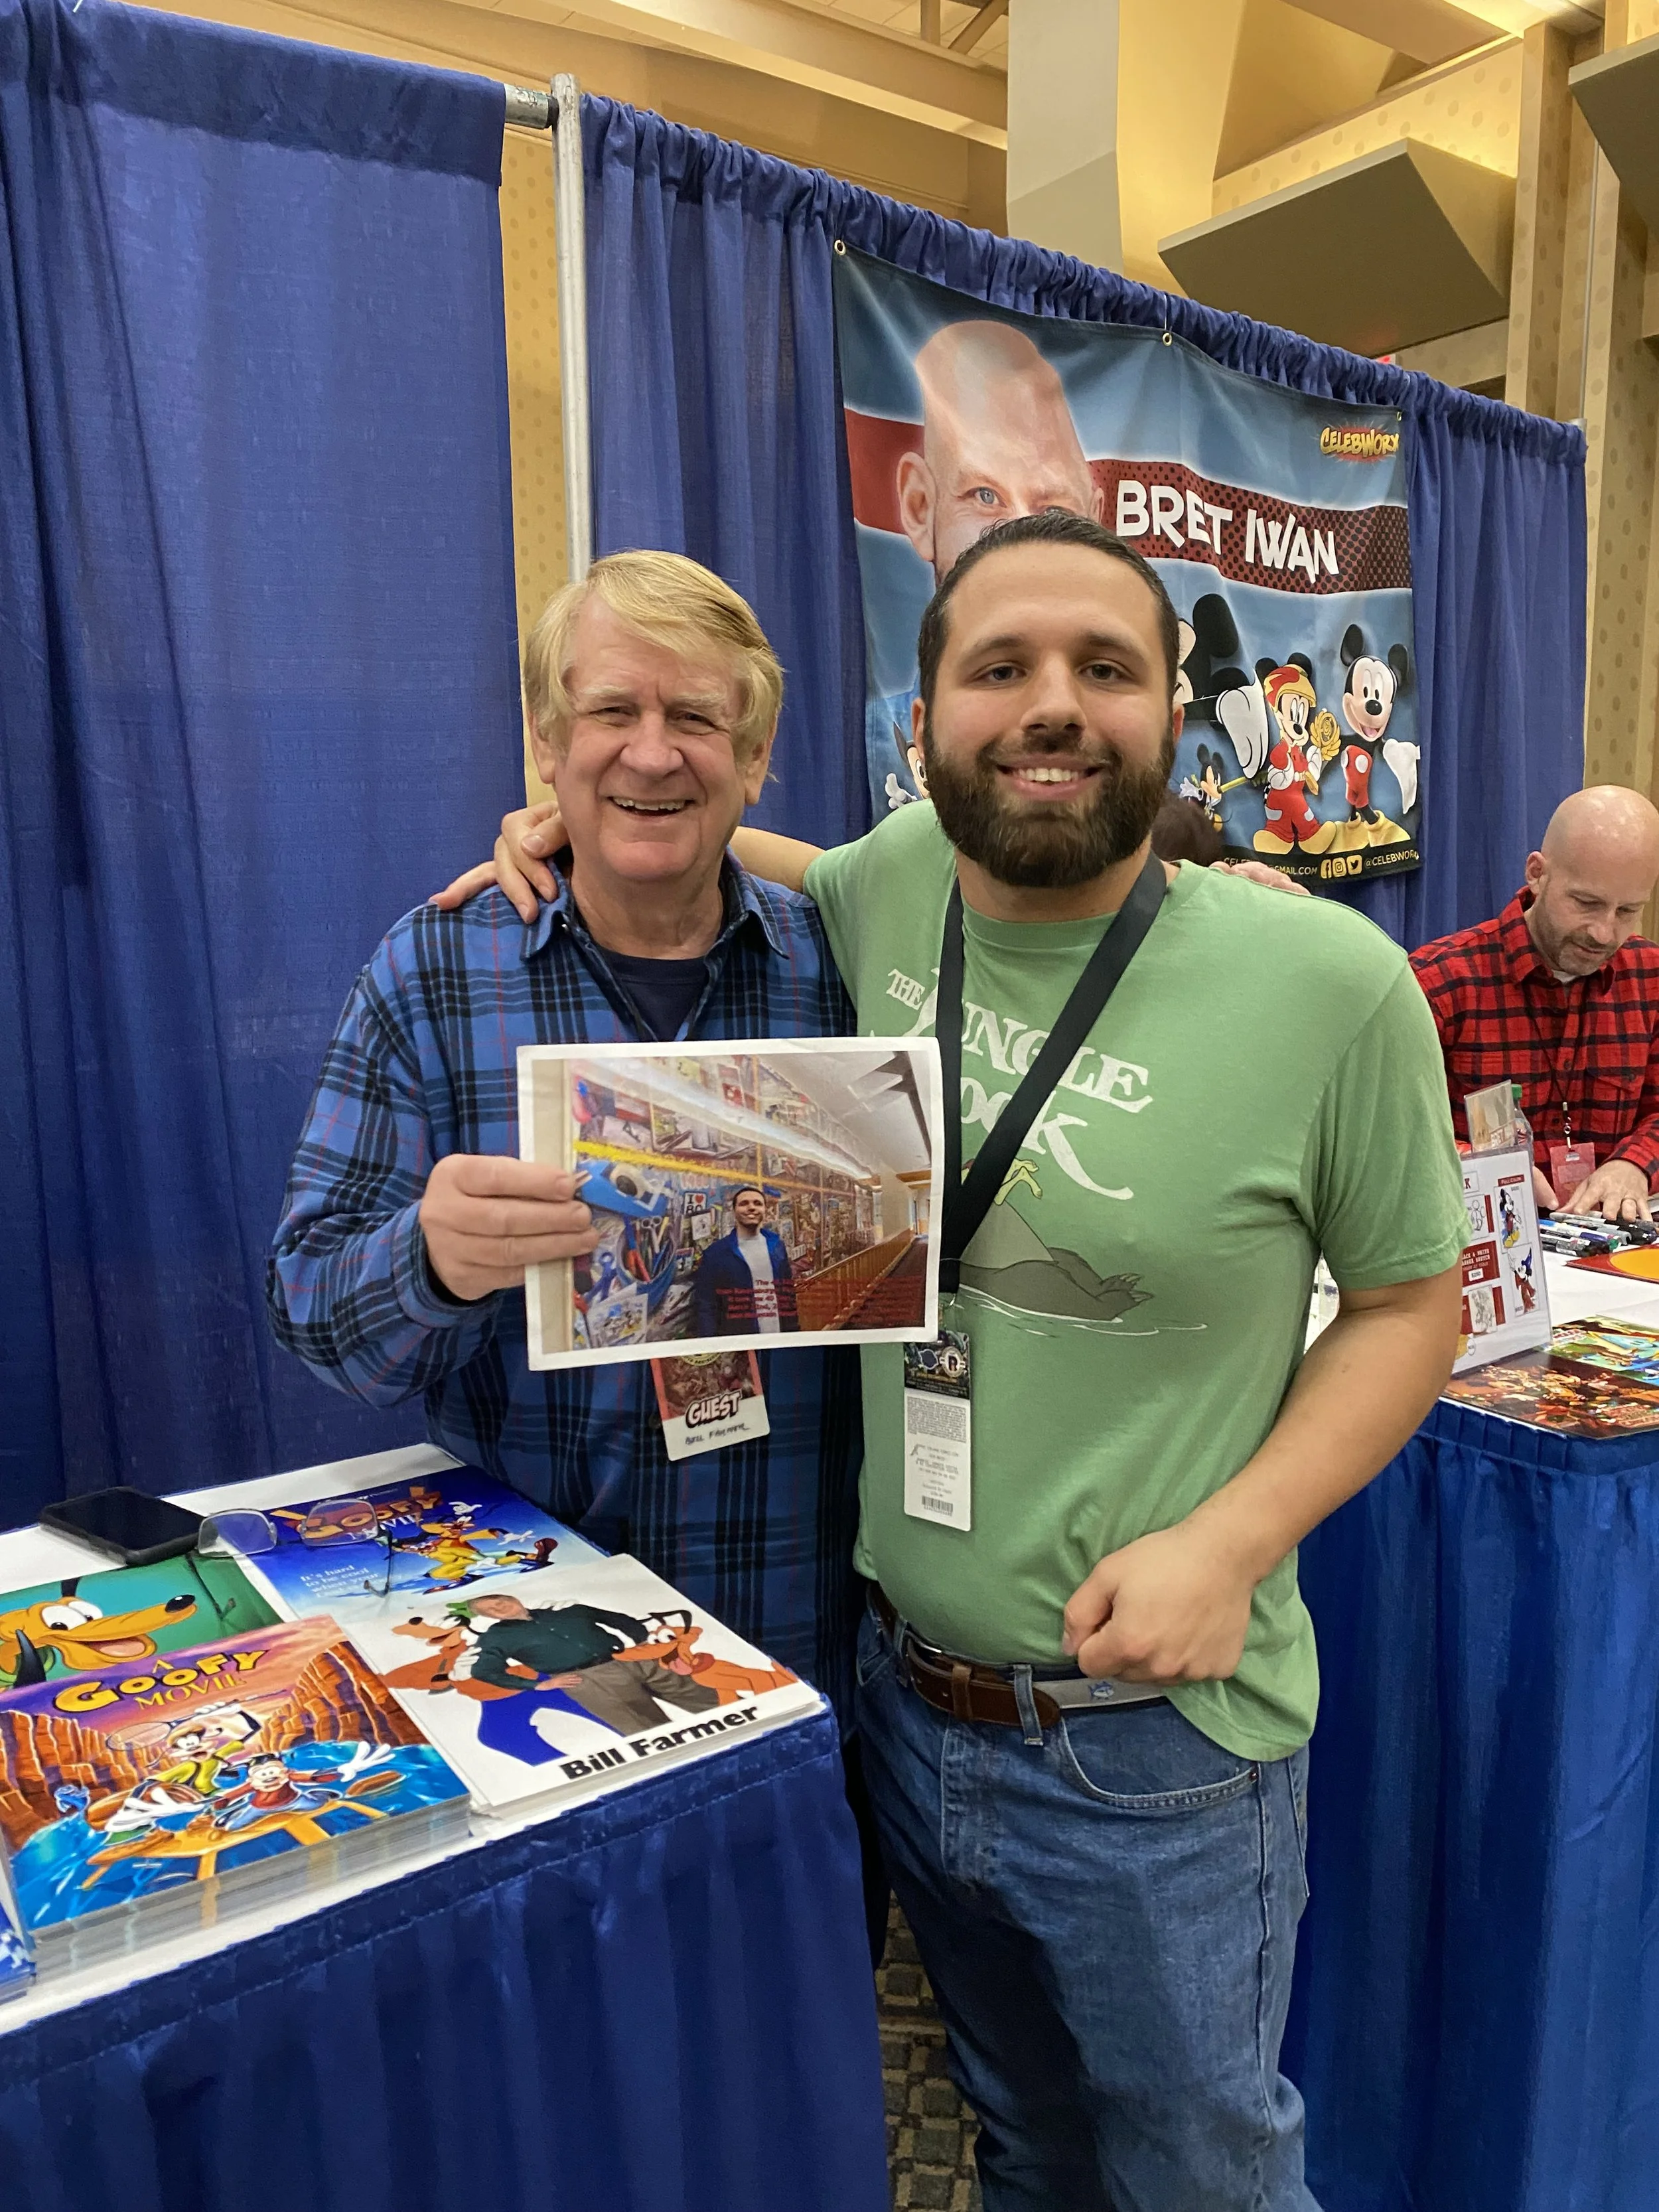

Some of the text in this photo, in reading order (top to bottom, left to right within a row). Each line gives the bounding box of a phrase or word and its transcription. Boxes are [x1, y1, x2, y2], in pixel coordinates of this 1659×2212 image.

[1116, 479, 1340, 584] BRET IWAN
[886, 968, 926, 1011] THE
[686, 1390, 742, 1428] GUEST
[324, 1564, 354, 1576] hard
[54, 1649, 267, 1712] GOOFY
[152, 1659, 175, 1674] A
[134, 1672, 248, 1710] MOVIE
[559, 1706, 758, 1780] Bill Farmer
